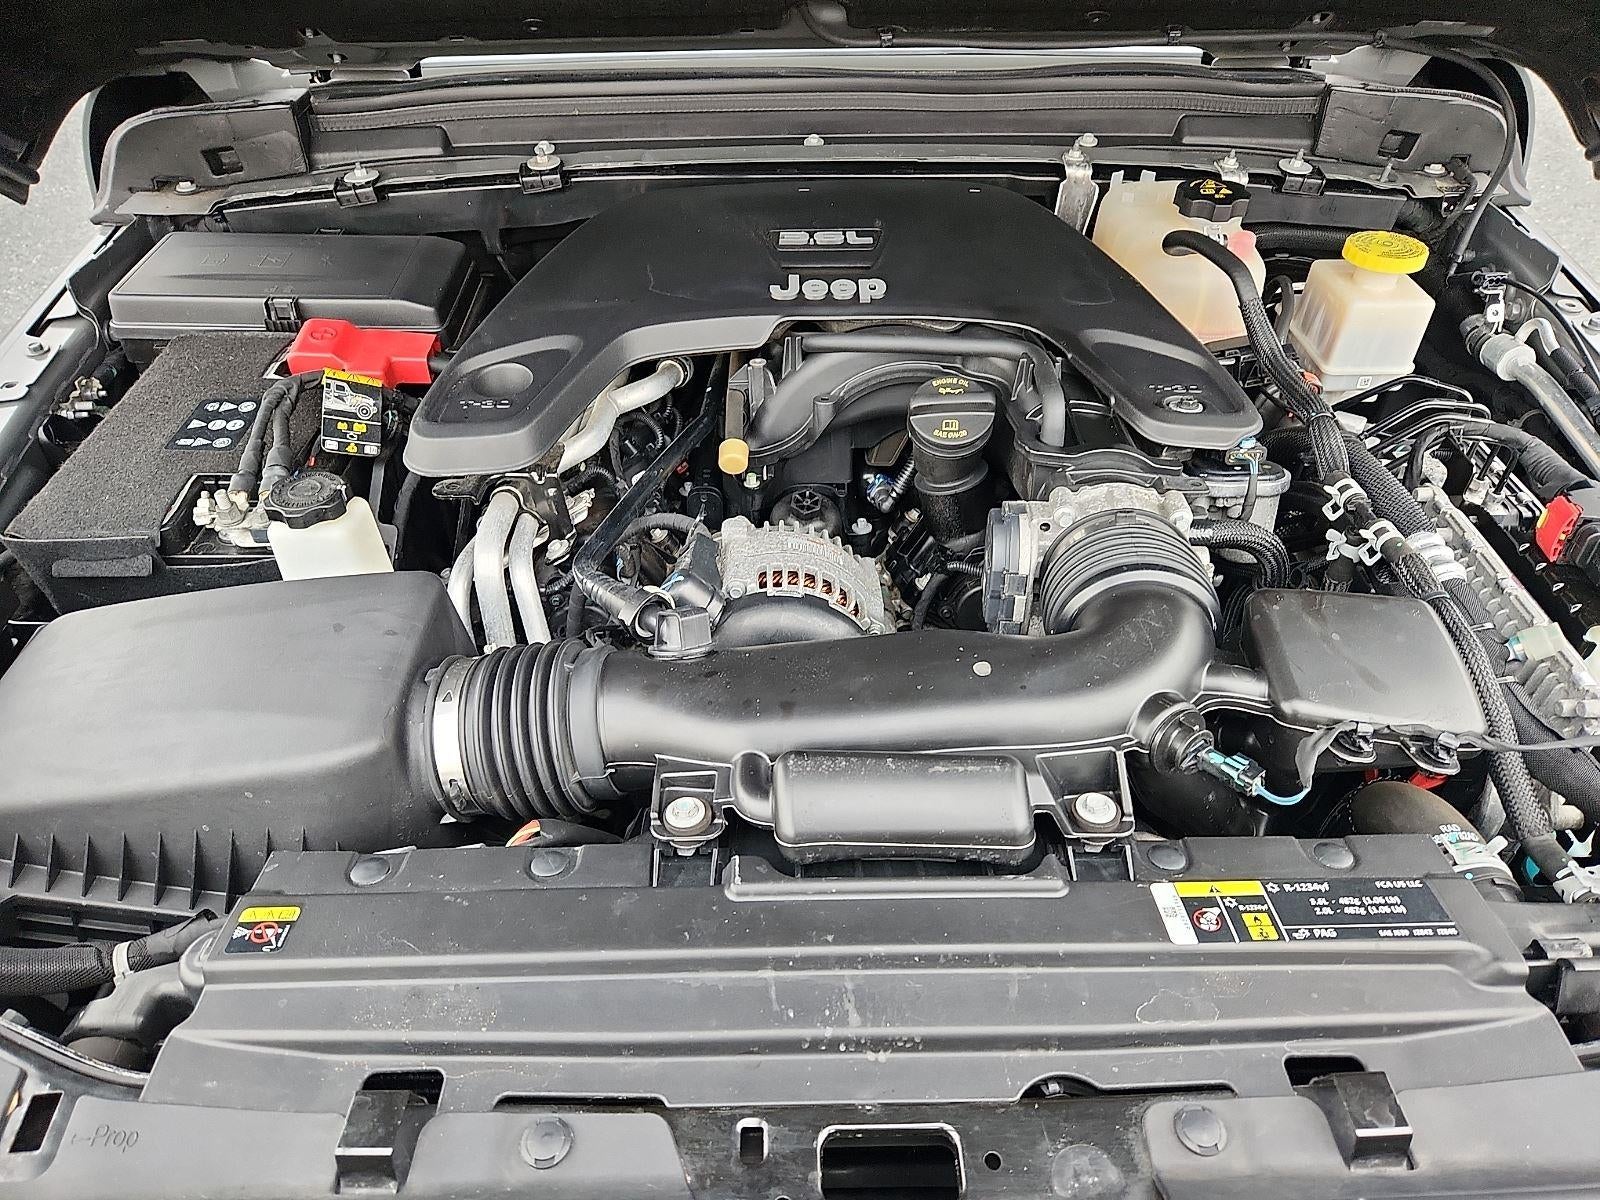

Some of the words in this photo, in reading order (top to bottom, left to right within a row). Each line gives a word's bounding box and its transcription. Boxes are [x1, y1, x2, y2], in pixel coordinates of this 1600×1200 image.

[769, 274, 887, 303] Jeep
[932, 378, 957, 387] ENGINE
[958, 379, 969, 387] OIL
[1439, 823, 1461, 833] RAD
[1312, 929, 1338, 938] PAG
